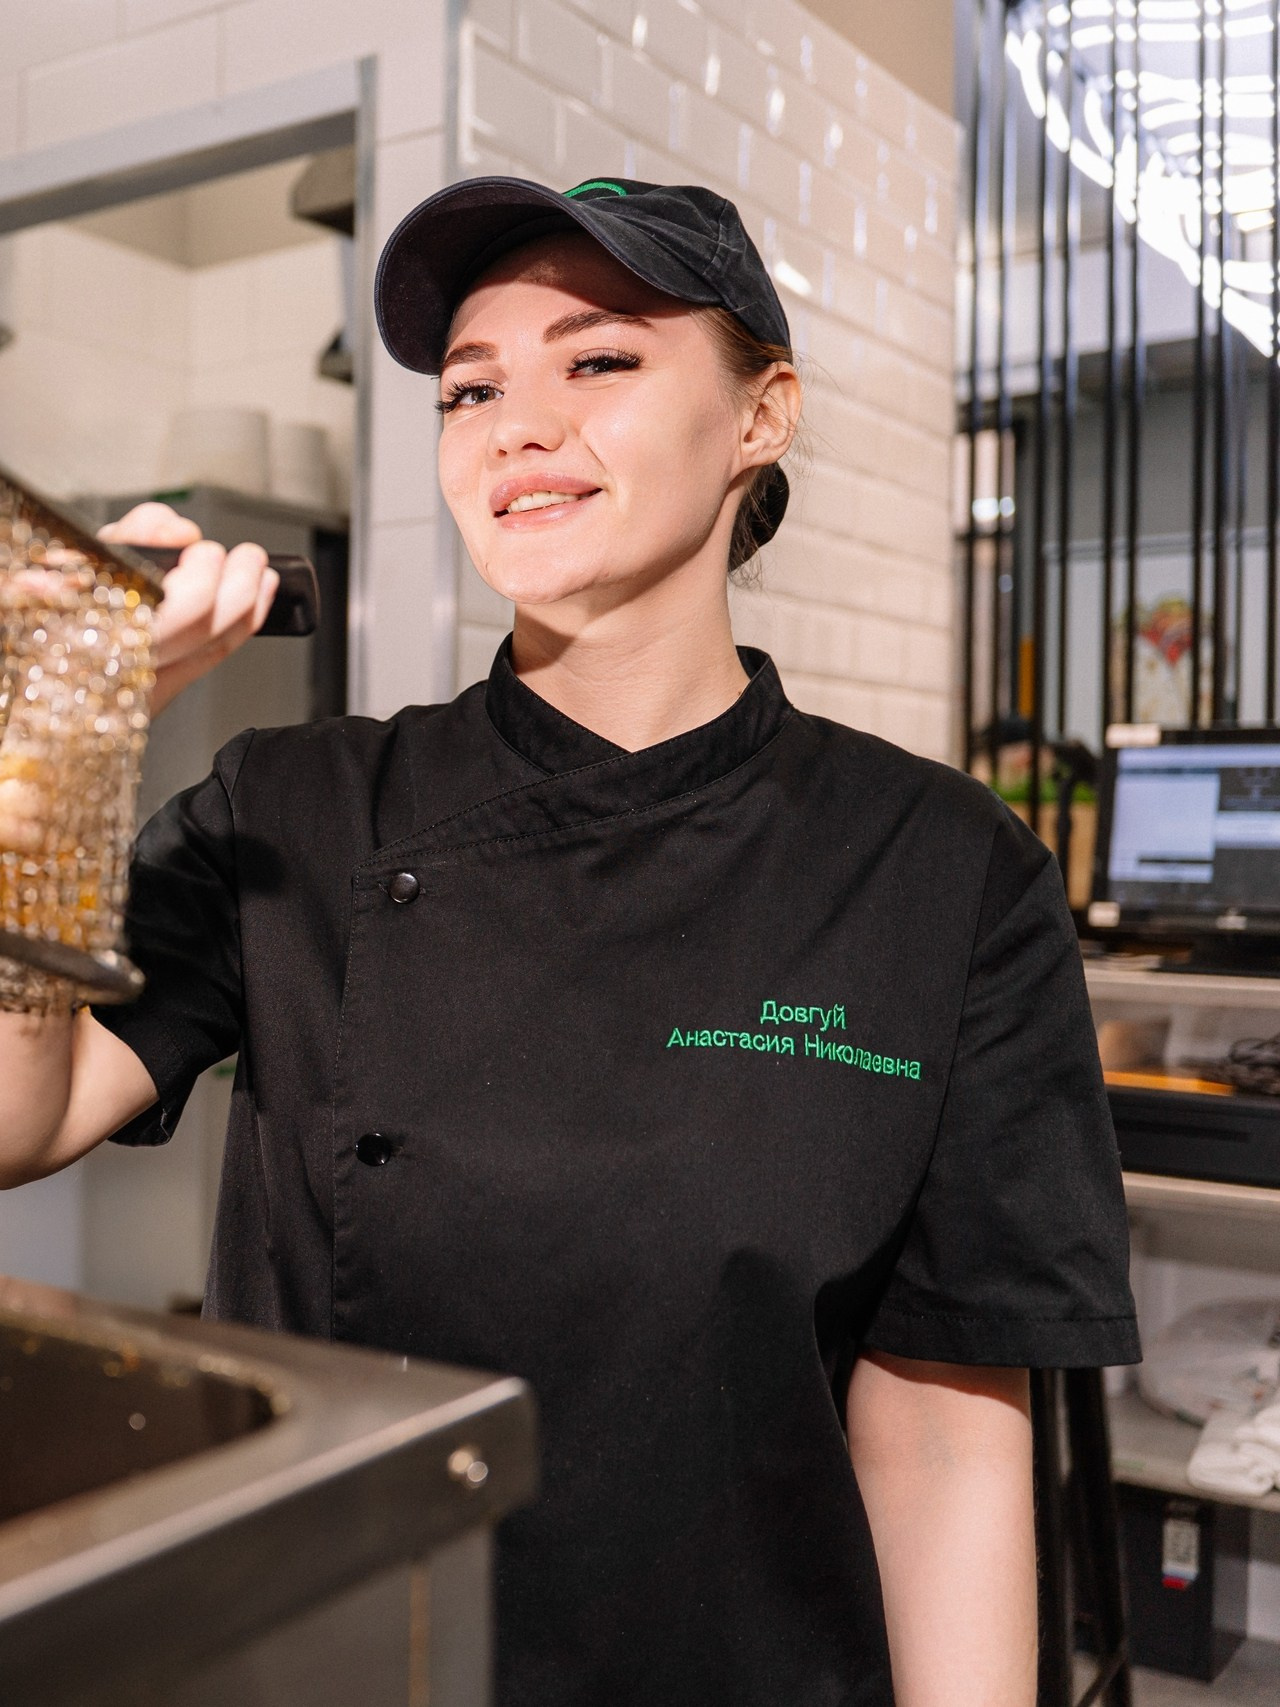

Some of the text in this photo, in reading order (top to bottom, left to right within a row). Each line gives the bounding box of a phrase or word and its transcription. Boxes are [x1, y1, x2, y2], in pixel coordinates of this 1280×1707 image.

[759, 999, 847, 1032] Довгуй
[666, 1027, 921, 1080] Анастасия Николаевна
